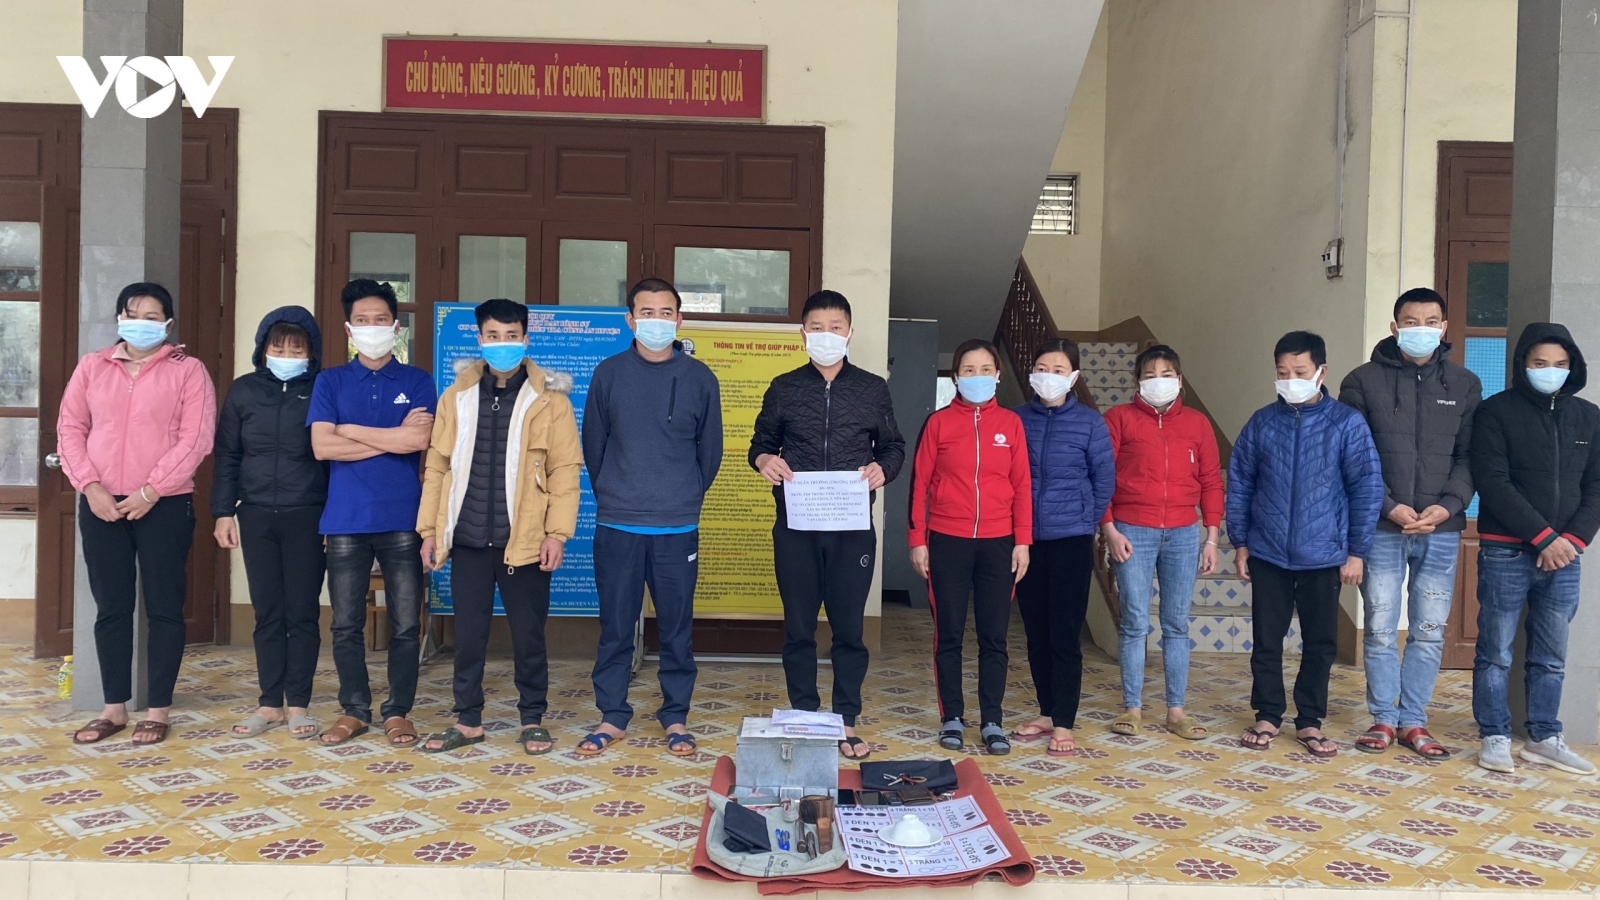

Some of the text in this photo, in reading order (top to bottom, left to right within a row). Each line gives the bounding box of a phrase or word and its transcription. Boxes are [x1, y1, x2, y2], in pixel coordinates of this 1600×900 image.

[406, 50, 743, 106] CHỦ ĐỘNG, NÊU GƯƠNG, KỶ CƯƠNG, TRÁCH NHIỆM, HIỆU QUẢ
[714, 342, 734, 350] THÔNG
[746, 341, 754, 350] VỀ
[755, 343, 767, 351] TRỢ
[783, 343, 800, 351] PHÁP
